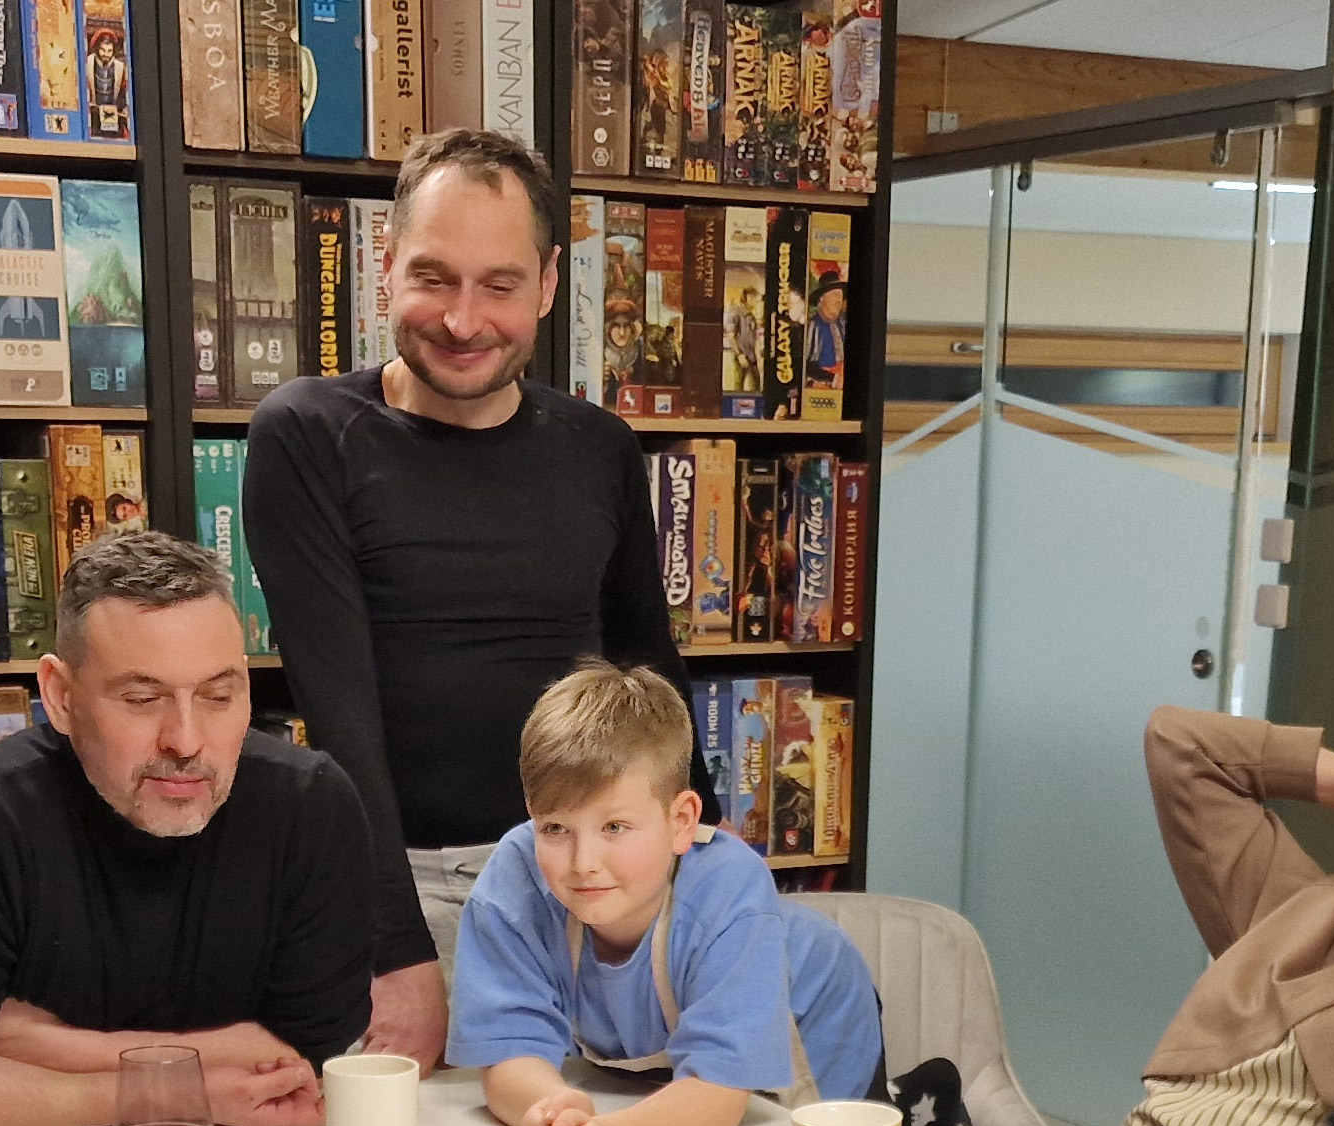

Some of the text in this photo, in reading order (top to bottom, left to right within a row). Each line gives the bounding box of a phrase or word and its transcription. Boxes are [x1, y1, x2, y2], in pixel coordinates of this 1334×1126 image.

[392, 0, 413, 99] gallerist
[496, 19, 523, 131] KANBAN
[733, 20, 759, 119] ARNAK
[778, 53, 796, 113] ARNAK
[813, 53, 829, 113] ARNAK
[704, 221, 716, 298] MAGISTER
[319, 232, 340, 378] DUNGEON LORDS
[776, 242, 793, 384] GALAXY TRUCKER
[22, 536, 37, 582] NEW ERA
[799, 496, 827, 571] Tribes
[843, 510, 858, 616] КОНКОРДИЯ
[707, 700, 719, 731] ROOM
[750, 741, 763, 784] GRENZE
